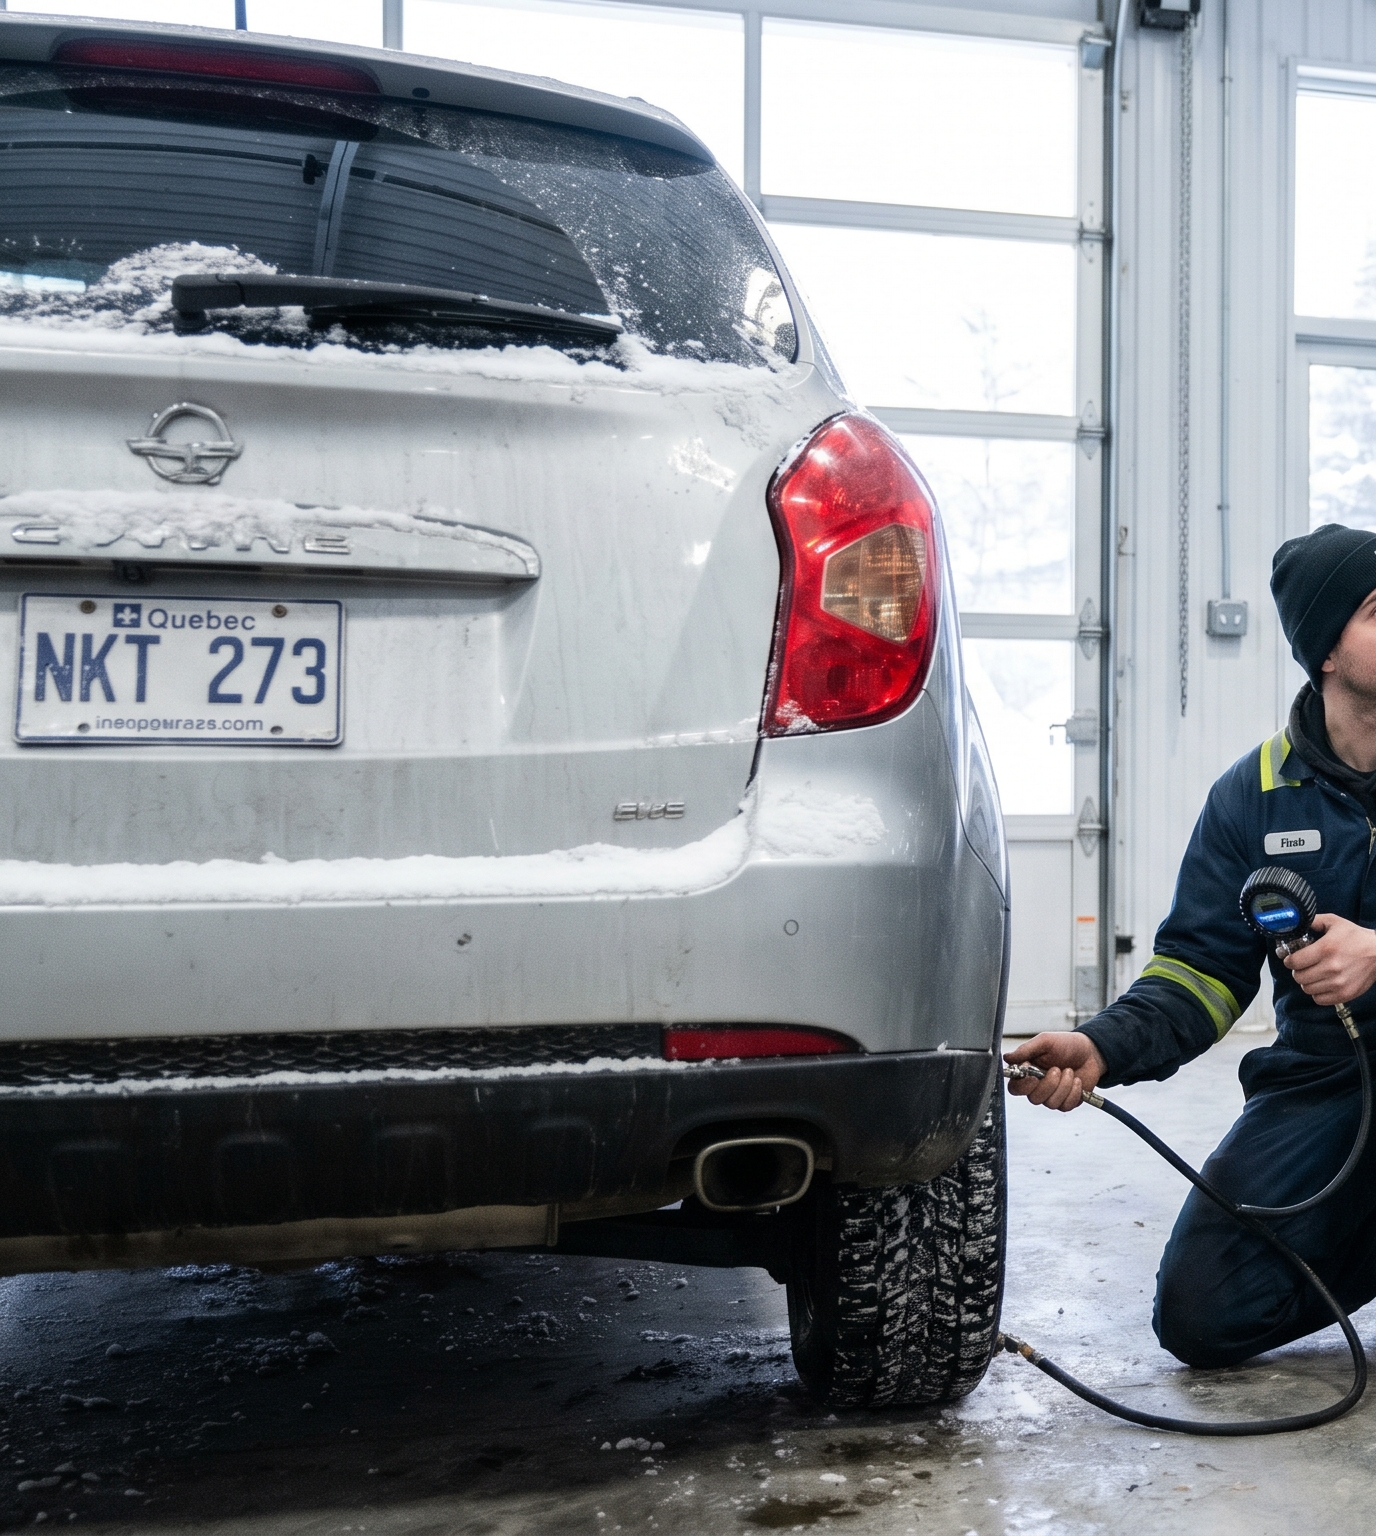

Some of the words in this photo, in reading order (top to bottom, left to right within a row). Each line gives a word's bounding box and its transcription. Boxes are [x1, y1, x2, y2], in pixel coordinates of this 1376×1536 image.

[147, 608, 257, 631] Quebec
[34, 631, 161, 703] NKT
[207, 635, 328, 705] 273
